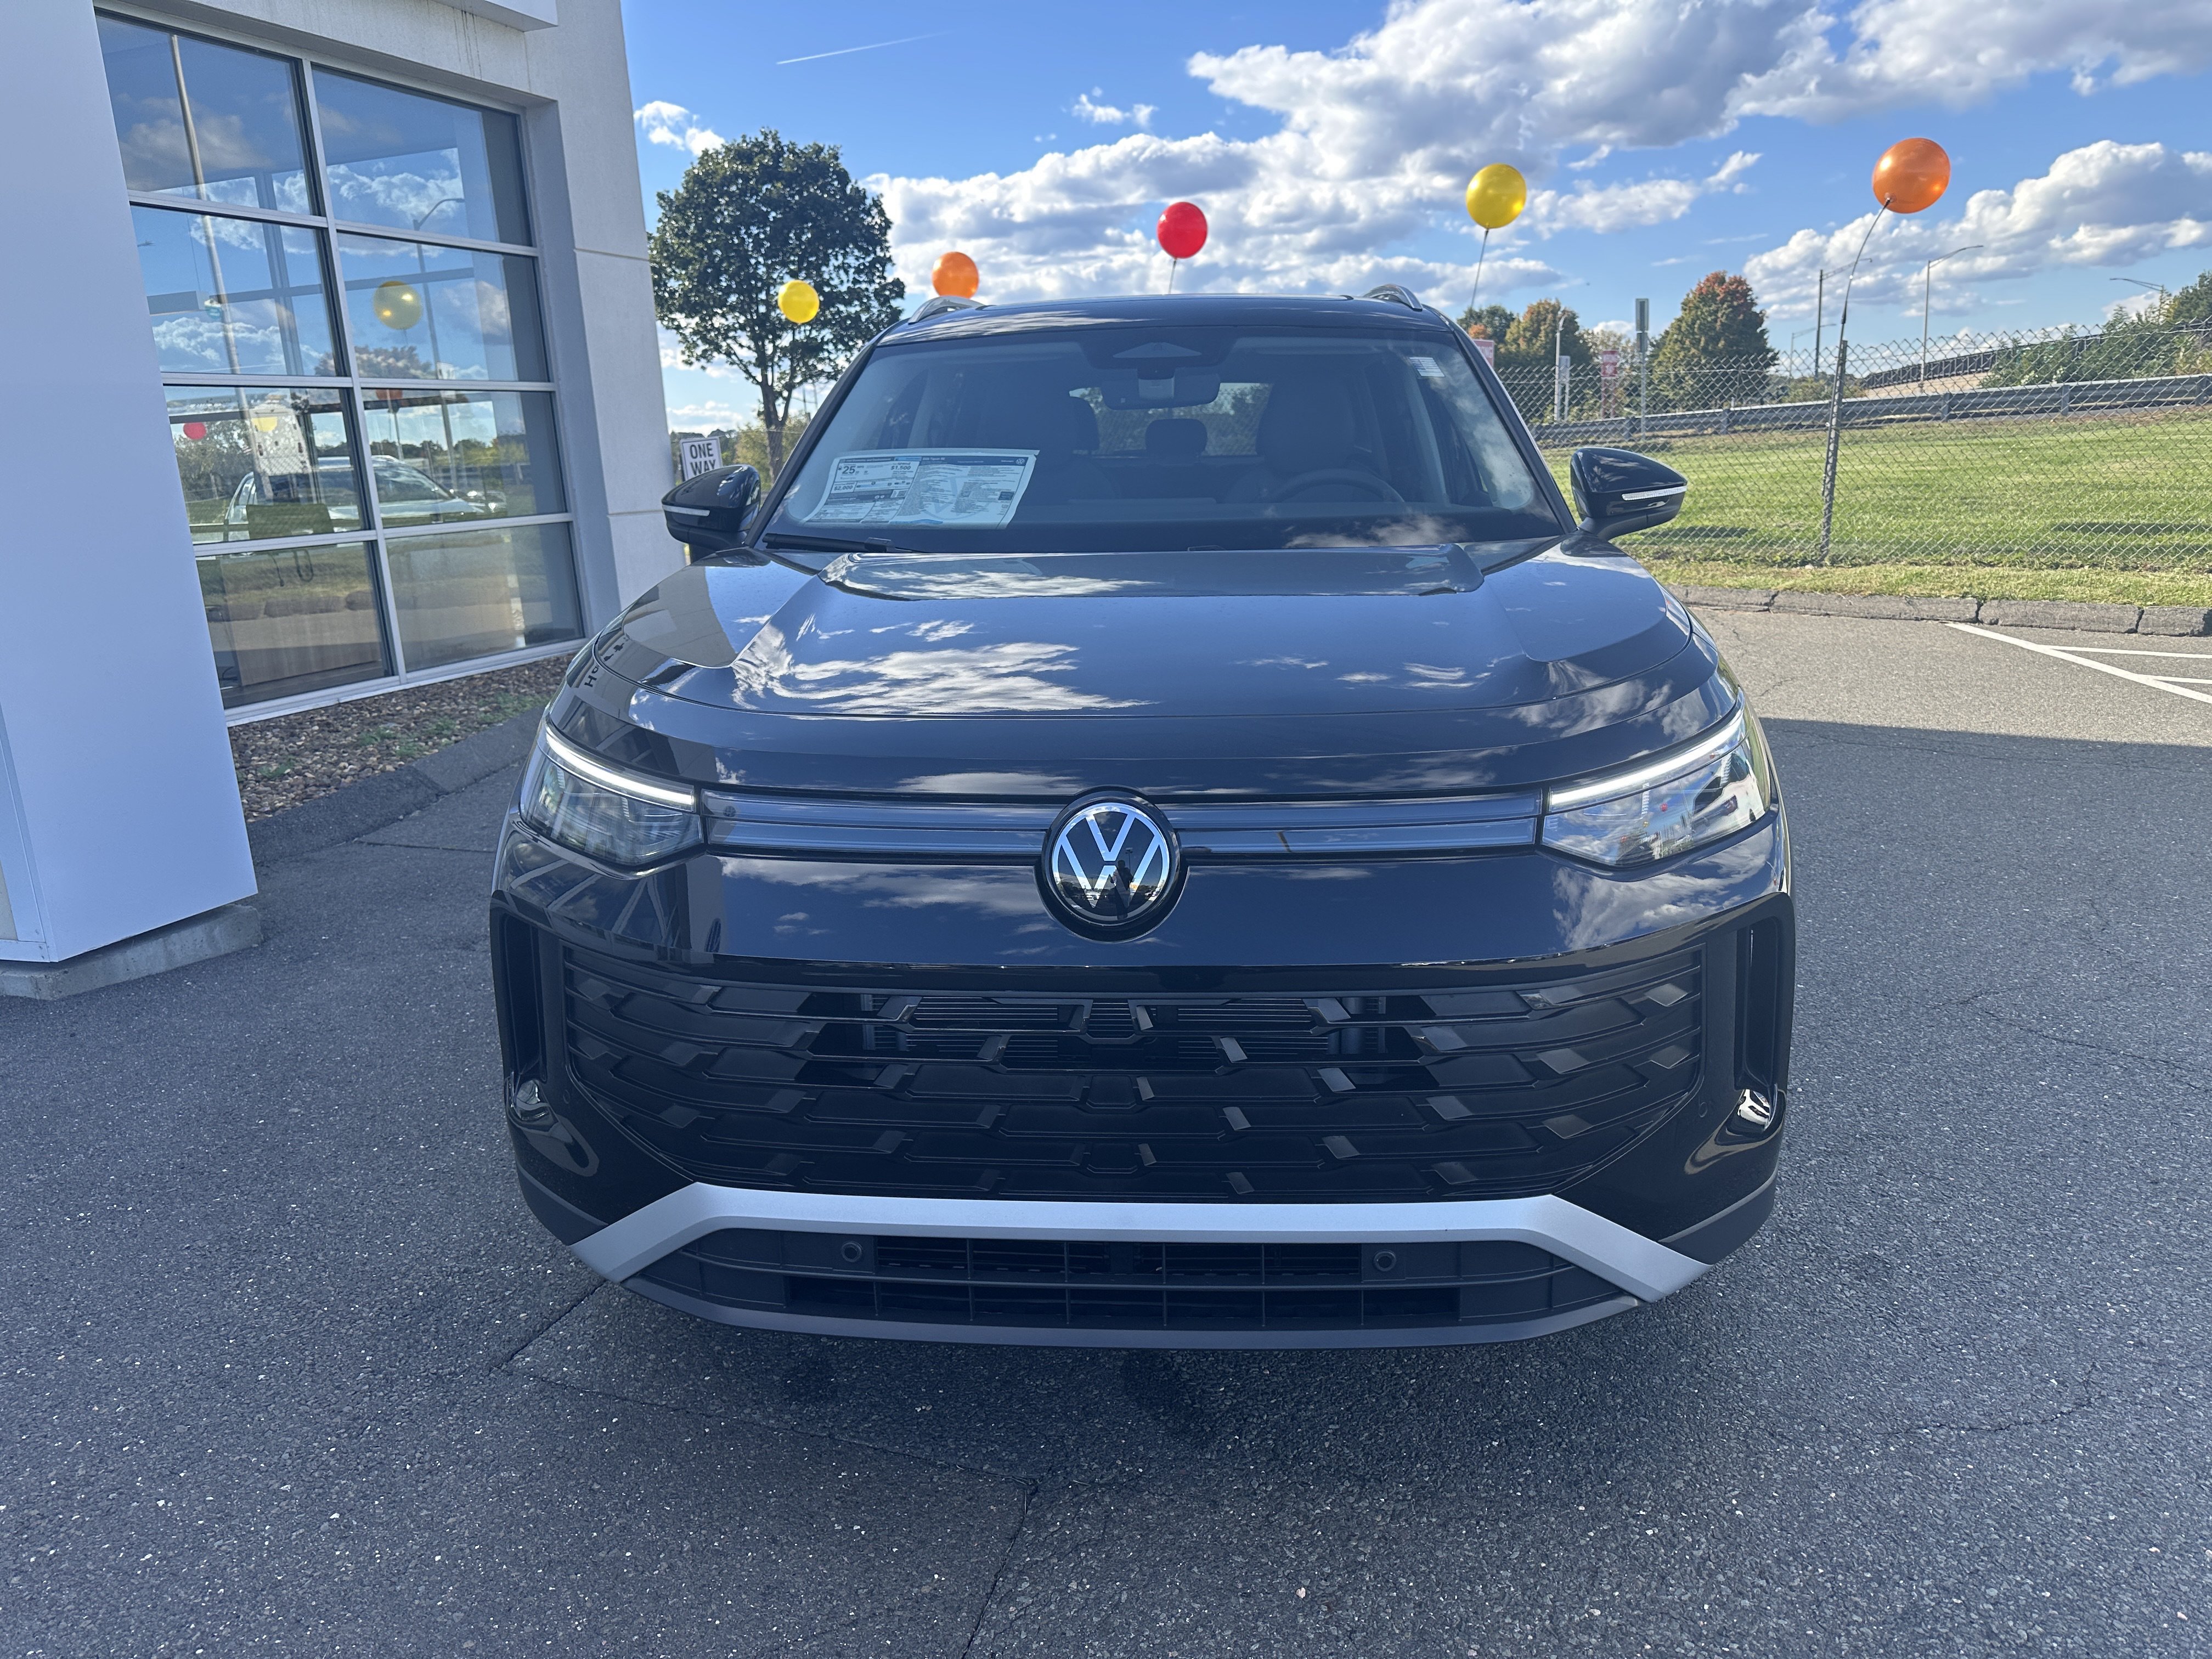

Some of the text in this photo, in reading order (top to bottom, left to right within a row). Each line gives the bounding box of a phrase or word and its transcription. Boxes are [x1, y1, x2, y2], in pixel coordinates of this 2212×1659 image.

[690, 443, 714, 459] ONE
[690, 459, 715, 476] WAY
[842, 466, 855, 475] 25
